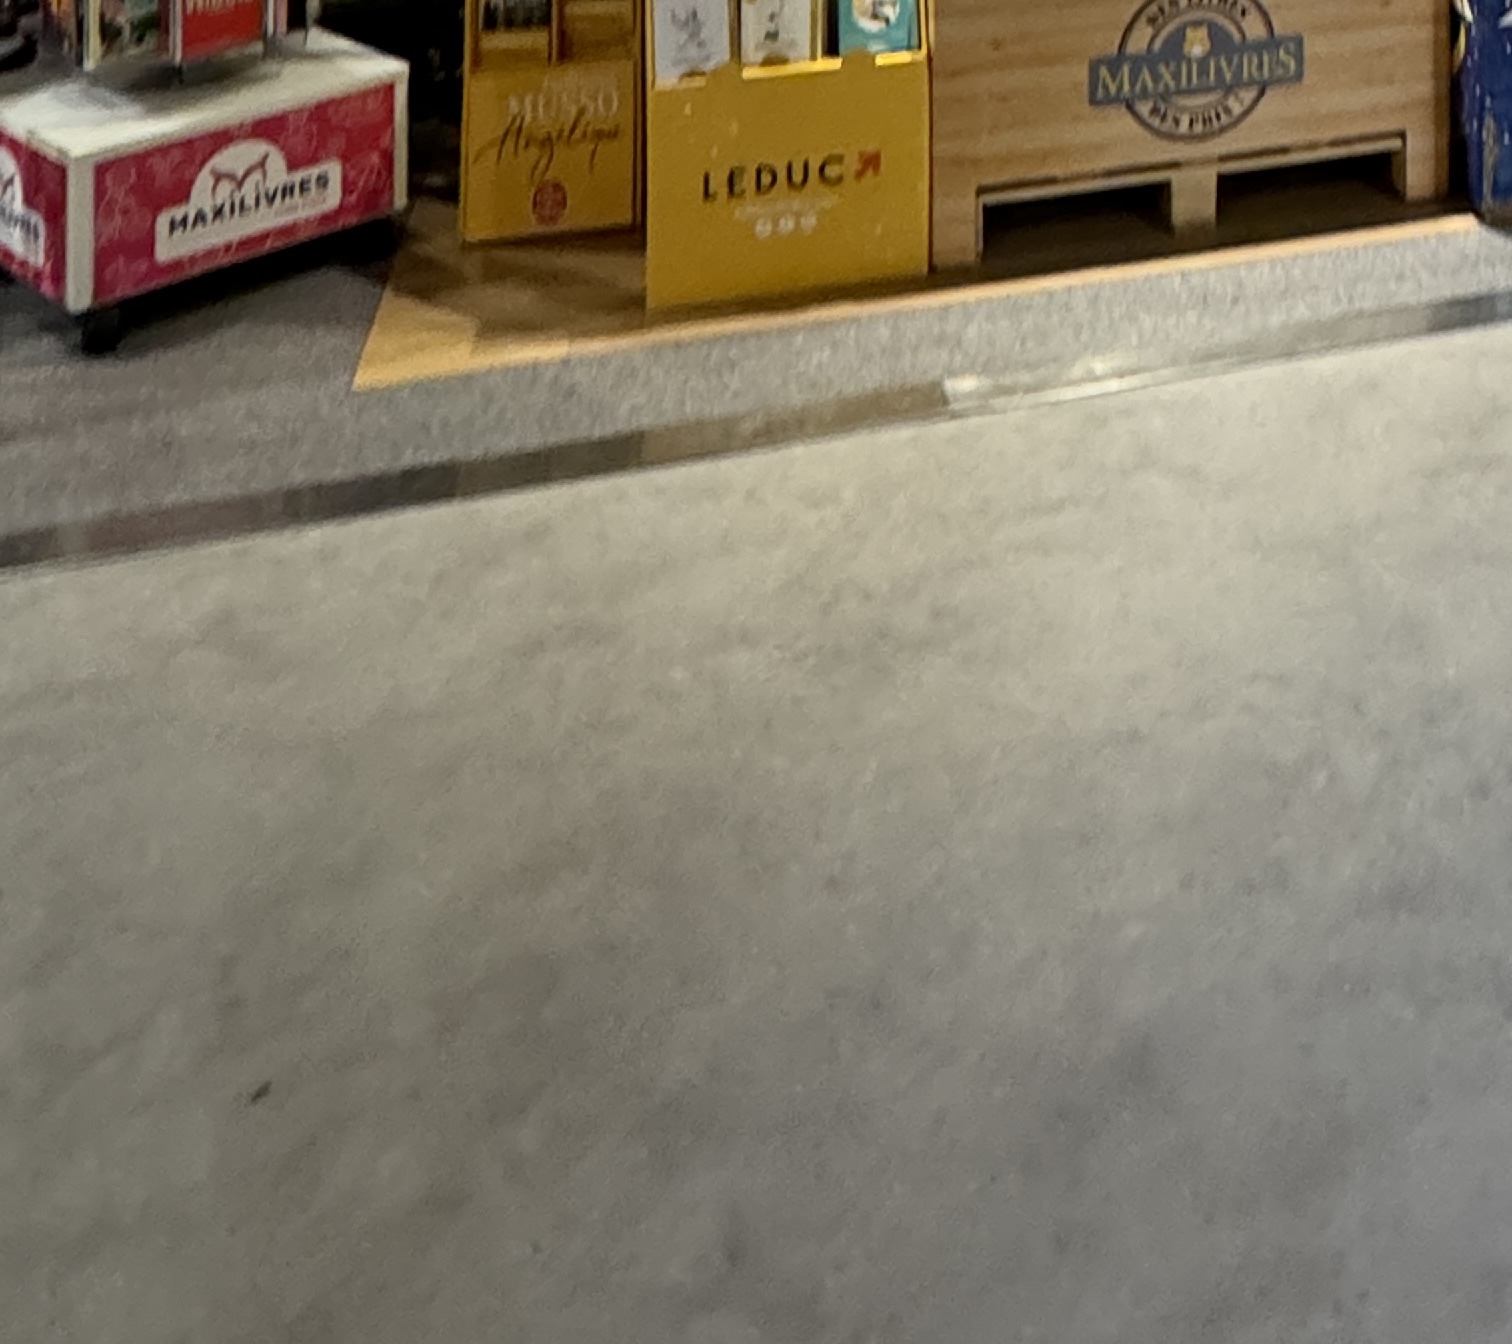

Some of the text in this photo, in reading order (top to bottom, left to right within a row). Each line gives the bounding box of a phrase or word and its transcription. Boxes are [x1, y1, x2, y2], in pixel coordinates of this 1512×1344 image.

[1095, 41, 1298, 103] MAXILIVRES
[167, 167, 331, 239] MAXILIVRES
[702, 152, 846, 204] LEDUC
